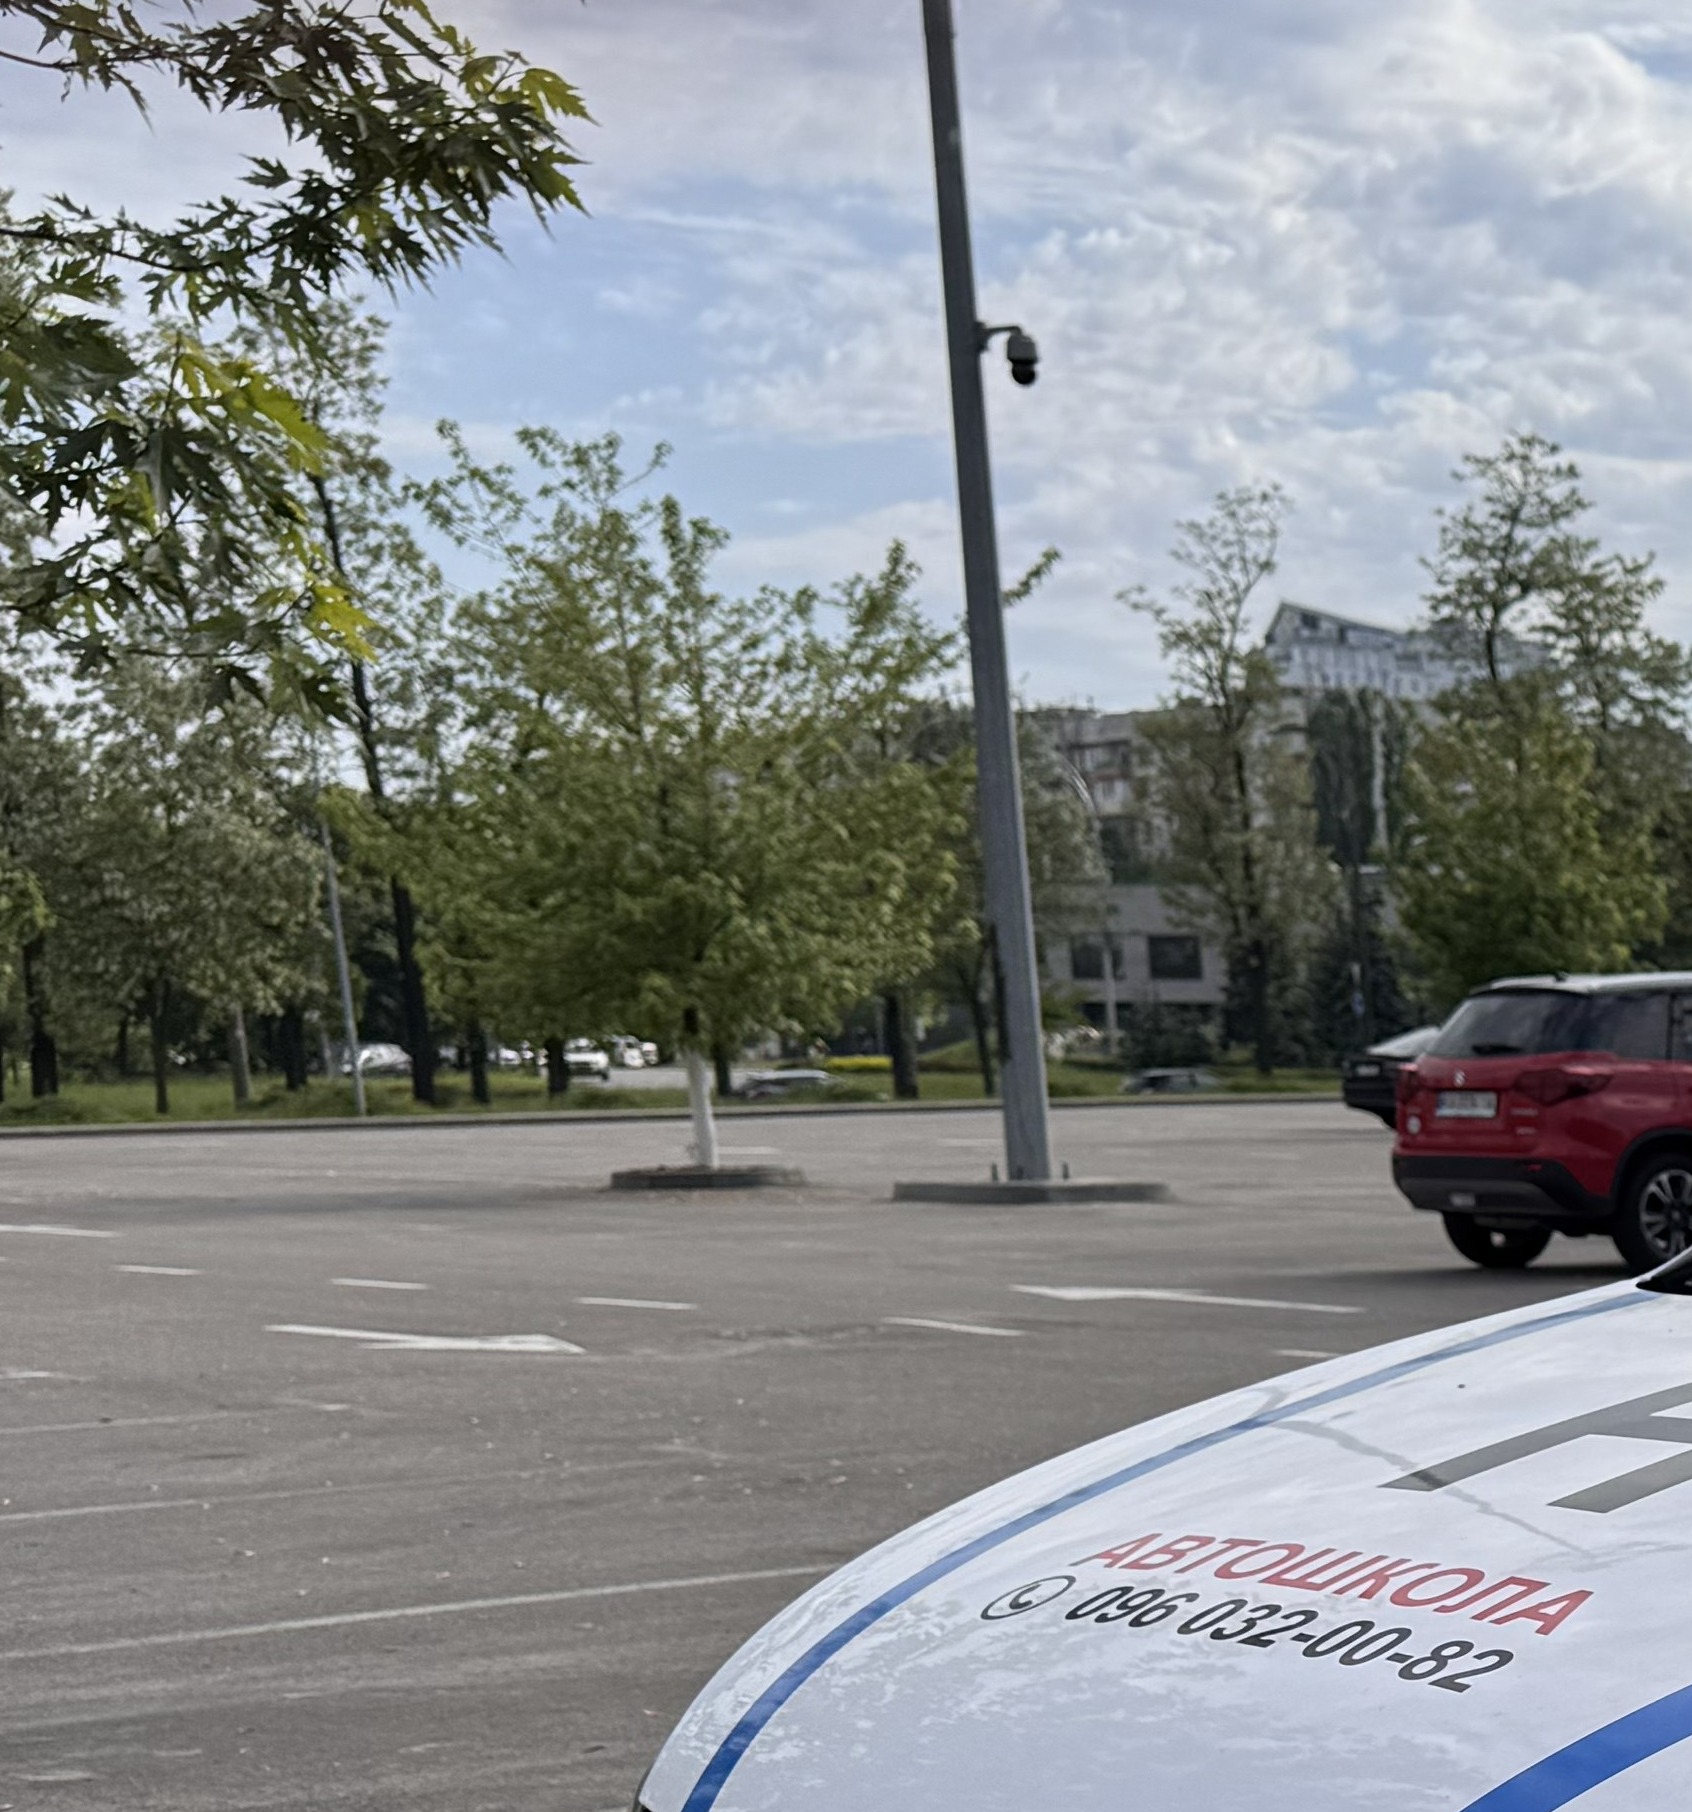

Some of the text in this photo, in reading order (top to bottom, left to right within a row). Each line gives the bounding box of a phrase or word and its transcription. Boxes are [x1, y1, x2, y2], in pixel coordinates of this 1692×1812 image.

[1068, 1532, 1595, 1636] АВТОШКОЛА
[1064, 1585, 1515, 1694] 096 032-00-82
